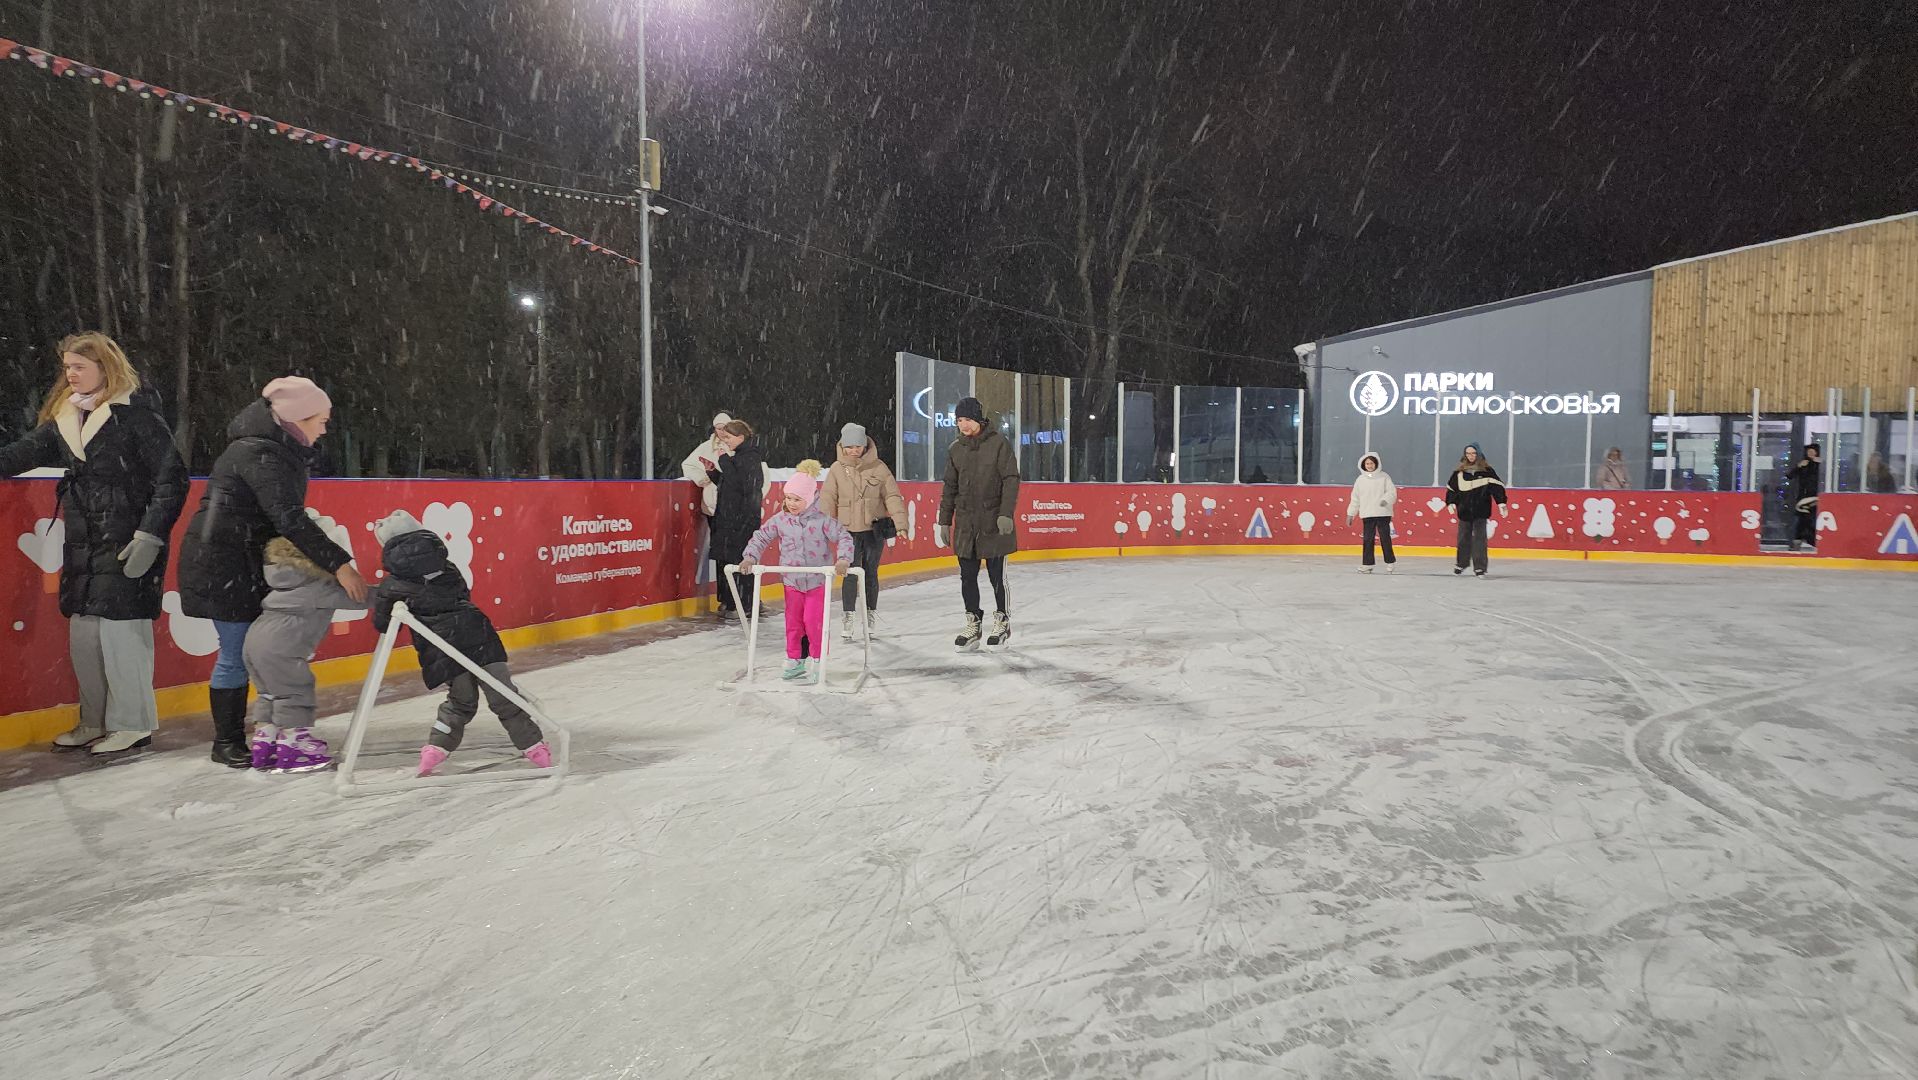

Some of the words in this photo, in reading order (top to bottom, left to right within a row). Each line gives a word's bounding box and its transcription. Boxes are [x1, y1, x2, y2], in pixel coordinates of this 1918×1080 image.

[1403, 371, 1494, 392] ПАРКИ
[1402, 394, 1621, 415] ПОДМОСКОВЬЯ
[562, 514, 633, 535] Катайтесь
[537, 546, 549, 561] с
[550, 538, 653, 566] удовольствием
[555, 571, 594, 585] Команда
[593, 565, 642, 581] губернатора
